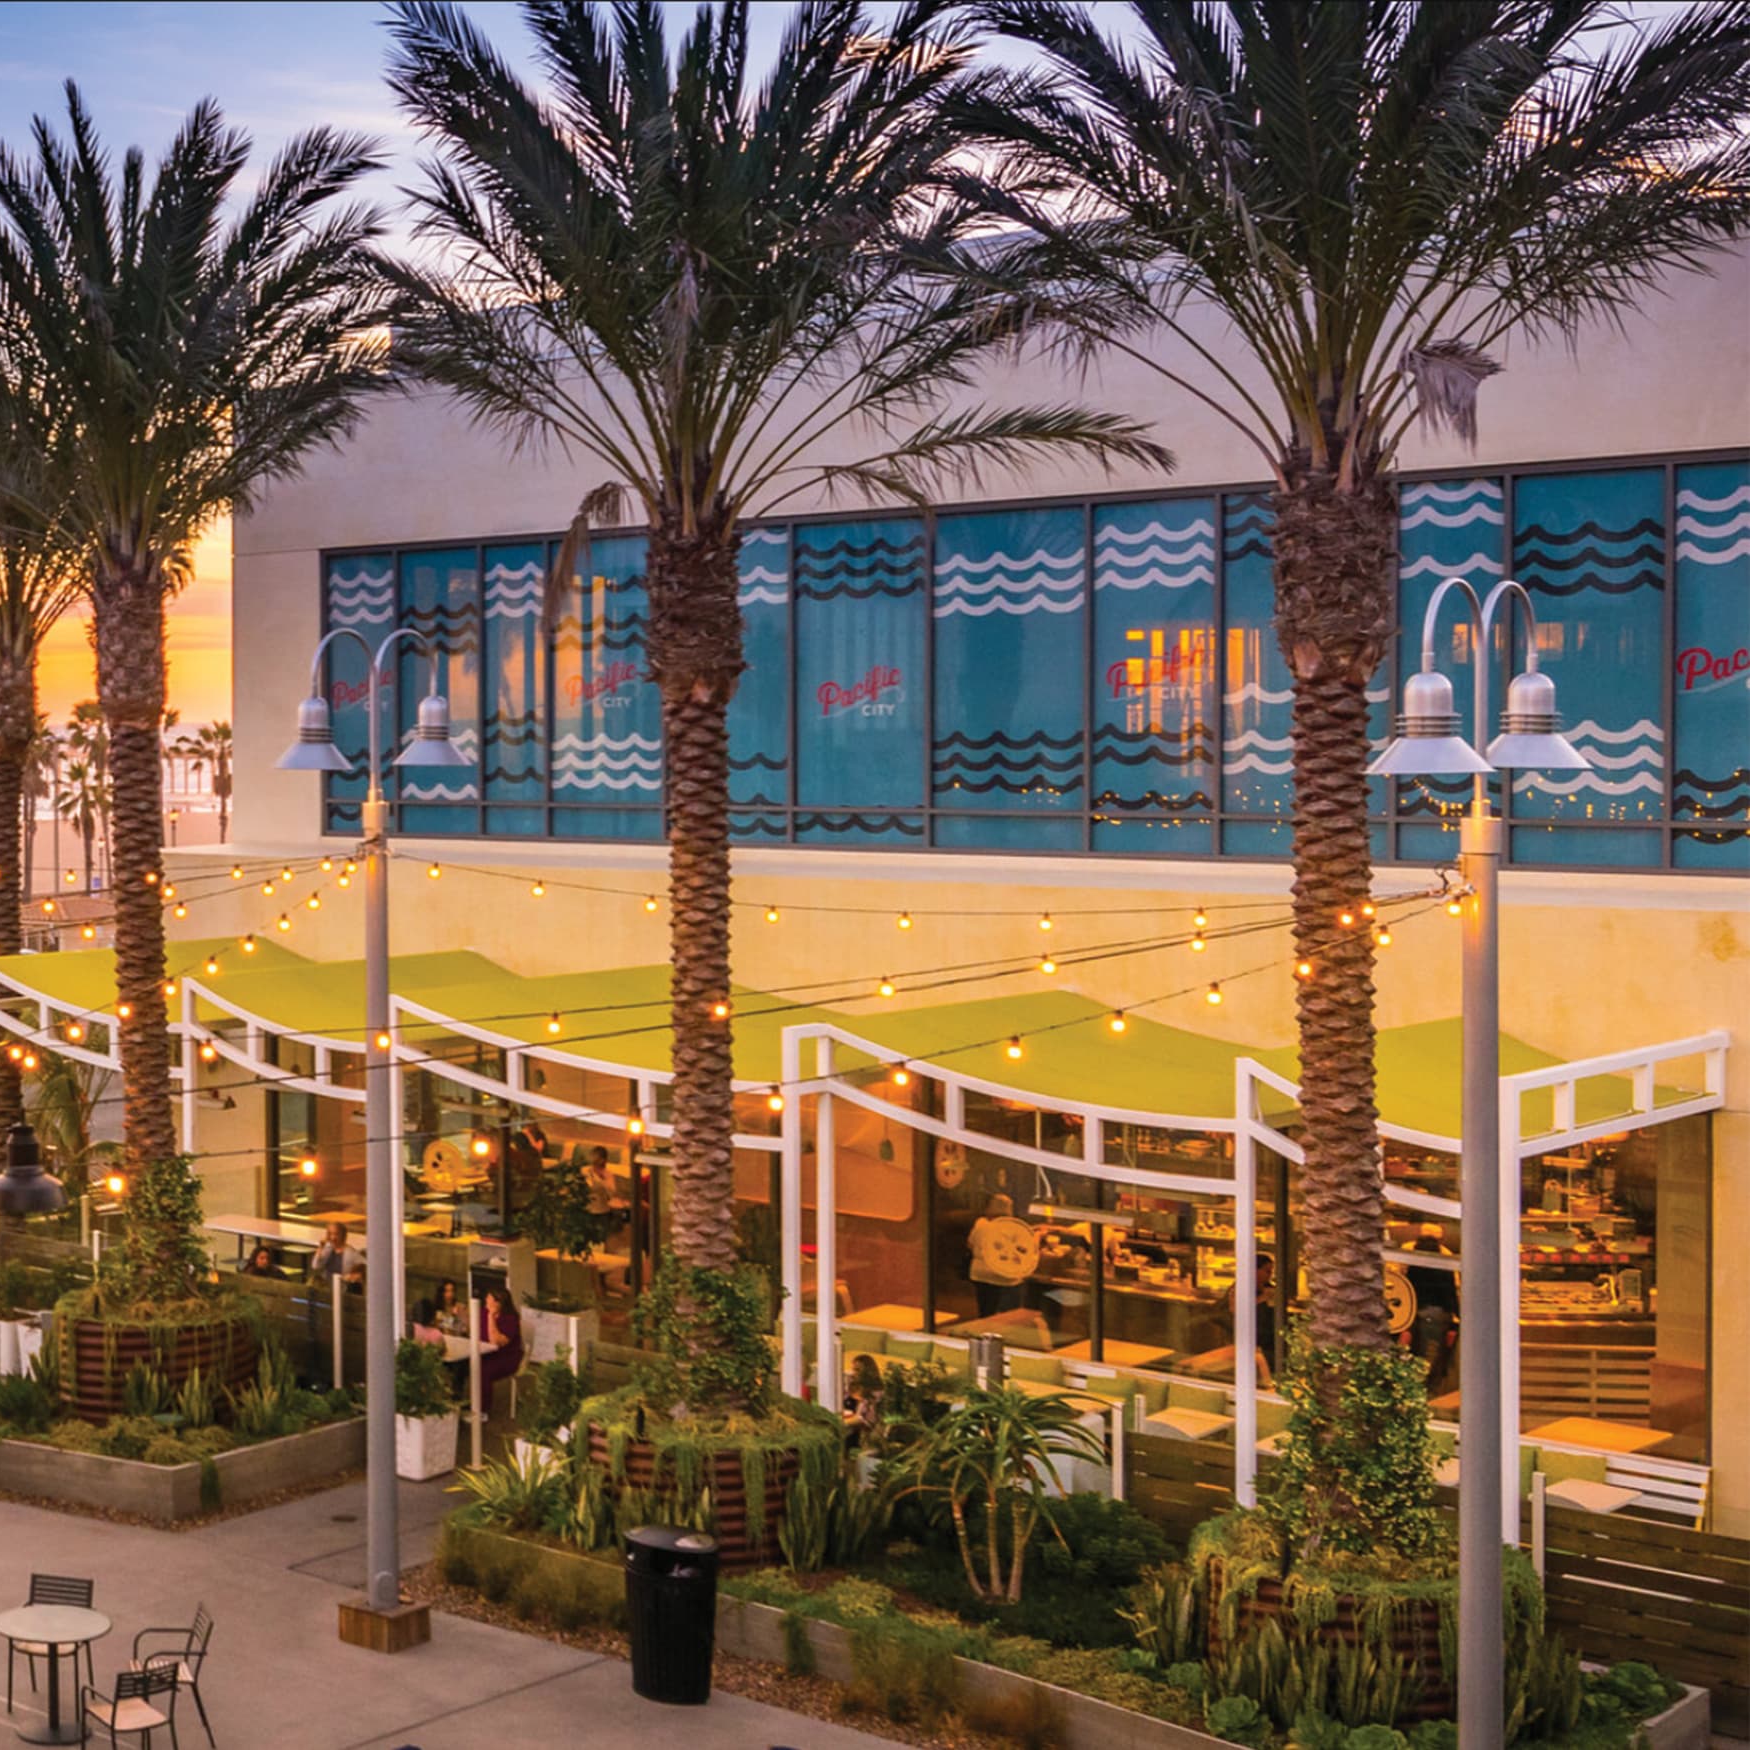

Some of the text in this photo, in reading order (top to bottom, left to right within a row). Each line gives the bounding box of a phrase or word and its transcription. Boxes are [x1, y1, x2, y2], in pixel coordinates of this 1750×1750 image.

[817, 664, 901, 716] Pacific
[1676, 647, 1750, 691] Pac
[861, 704, 895, 717] CITY
